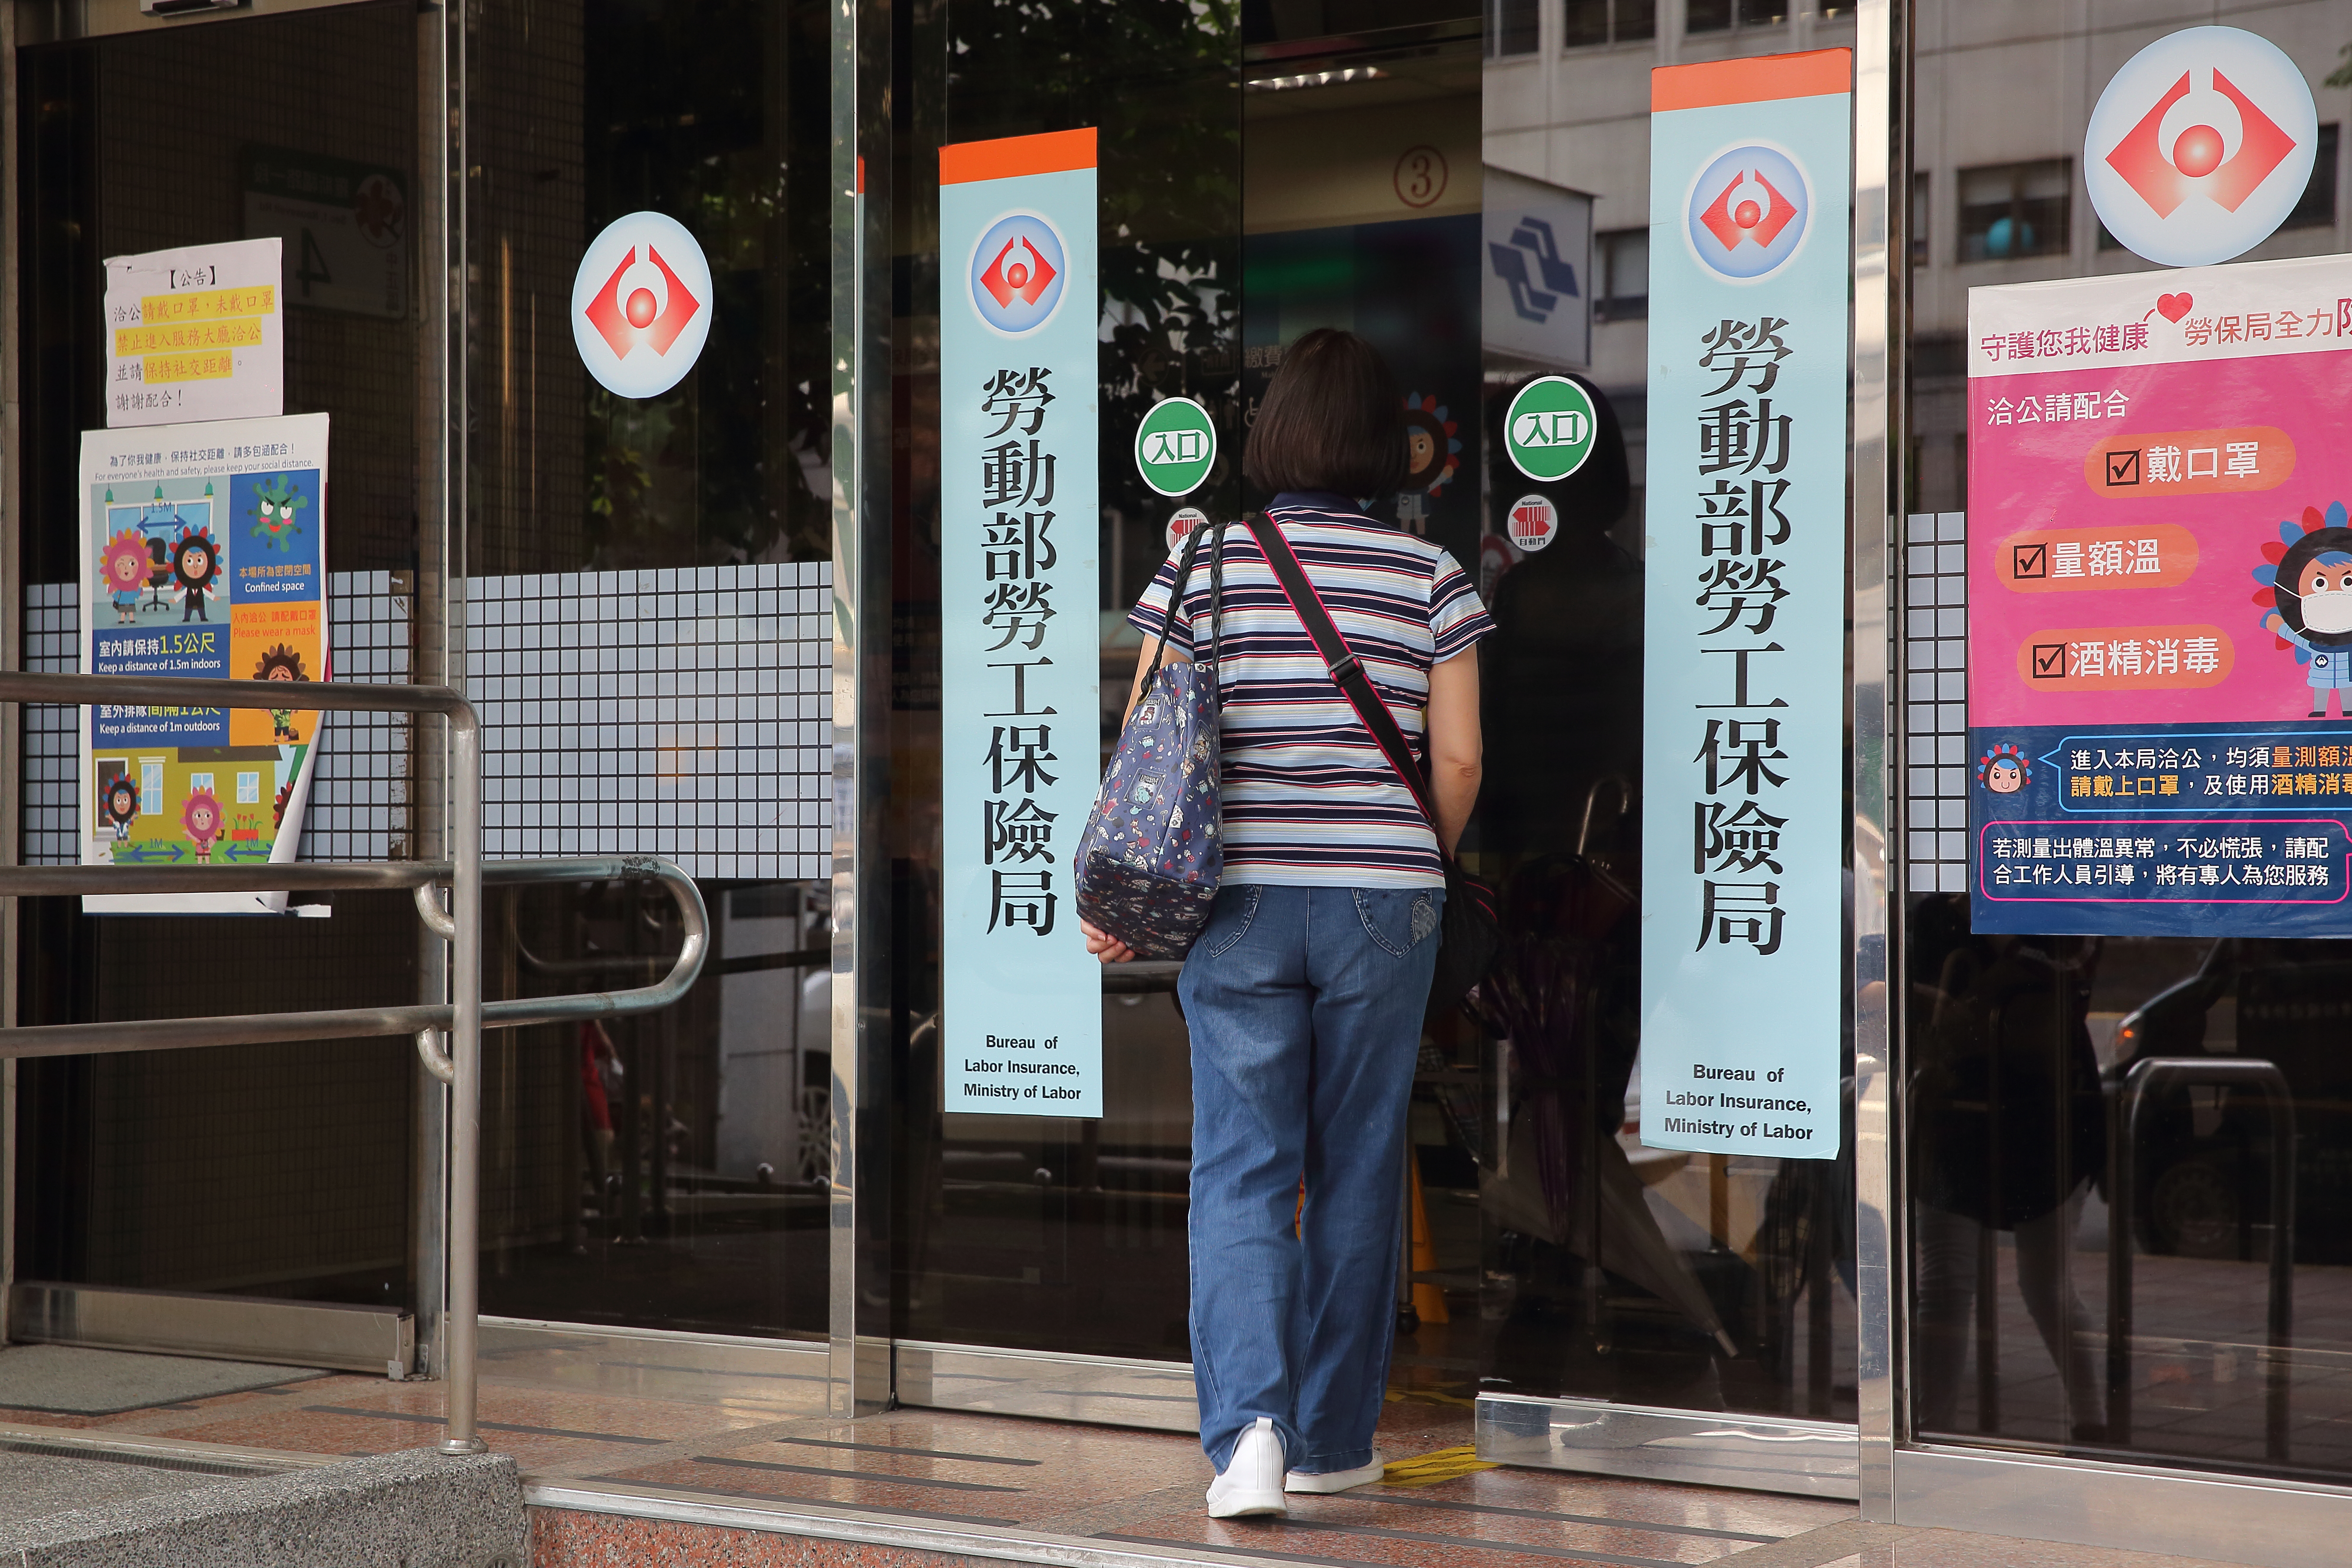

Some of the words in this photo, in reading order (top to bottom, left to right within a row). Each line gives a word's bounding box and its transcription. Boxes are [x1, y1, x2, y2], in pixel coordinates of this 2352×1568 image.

[114, 291, 274, 323] 洽公請戴口罩，未戴口罩
[118, 323, 261, 352] 禁止進入服務大廳洽公
[1980, 322, 2150, 362] 守護您我健康
[115, 357, 242, 381] 並請保持社交距離。
[115, 390, 183, 411] 謝謝配合！
[1987, 388, 2130, 426] 洽公請配合
[1522, 413, 1579, 446] 入口
[1151, 431, 1201, 463] 入口
[95, 472, 105, 481] For
[107, 470, 142, 482] everyone's
[144, 468, 165, 477] health
[166, 466, 179, 476] and
[180, 465, 202, 476] safety,
[204, 464, 225, 475] please
[226, 463, 243, 473] keep
[244, 462, 260, 473] your
[261, 460, 280, 470] social
[282, 459, 314, 469] distance.
[2146, 441, 2261, 484] 戴口罩
[151, 502, 172, 514] 1.5M
[2051, 538, 2161, 579] 量額溫
[239, 564, 311, 579] 本場所為密閉空間
[245, 581, 280, 593] Confined
[281, 582, 305, 593] space
[233, 627, 260, 638] Please
[262, 628, 283, 637] wear
[293, 624, 316, 636] mask
[1693, 317, 1793, 955] 勞動部勞工保險局
[99, 632, 215, 657] 室內請保持1.5公尺
[981, 367, 1060, 936] 勞動部勞工保險局
[99, 662, 117, 674] Keep
[125, 660, 158, 672] distance
[159, 659, 168, 670] of
[169, 659, 189, 670] 1.5m
[191, 658, 221, 669] indoors
[2070, 636, 2220, 677] 酒精消毒
[100, 723, 120, 736] Keep
[120, 725, 126, 734] a
[126, 722, 158, 734] distance
[159, 721, 168, 732] of
[170, 721, 182, 732] 1m
[184, 720, 220, 732] outdoors
[149, 838, 163, 848] 1M
[246, 837, 259, 848] 1M
[1992, 837, 2329, 859] 若測量出體溫異常，不必慌張，請配
[1993, 863, 2329, 886] 合工作人員引導，將有專人為您服務
[986, 1035, 1036, 1049] Bureau
[1044, 1036, 1058, 1049] of
[965, 1058, 1003, 1073] Labor
[1008, 1060, 1080, 1077] Insurance,
[1693, 1064, 1755, 1081] Bureau
[1767, 1067, 1784, 1083] of
[964, 1083, 1020, 1101] Ministry
[1024, 1085, 1037, 1098] of
[1042, 1086, 1082, 1100] Labor
[1666, 1090, 1714, 1107] Labor
[1720, 1093, 1812, 1115] Insurance,
[1664, 1118, 1735, 1138] Ministry
[1740, 1122, 1758, 1137] of
[1764, 1123, 1813, 1140] Labor
